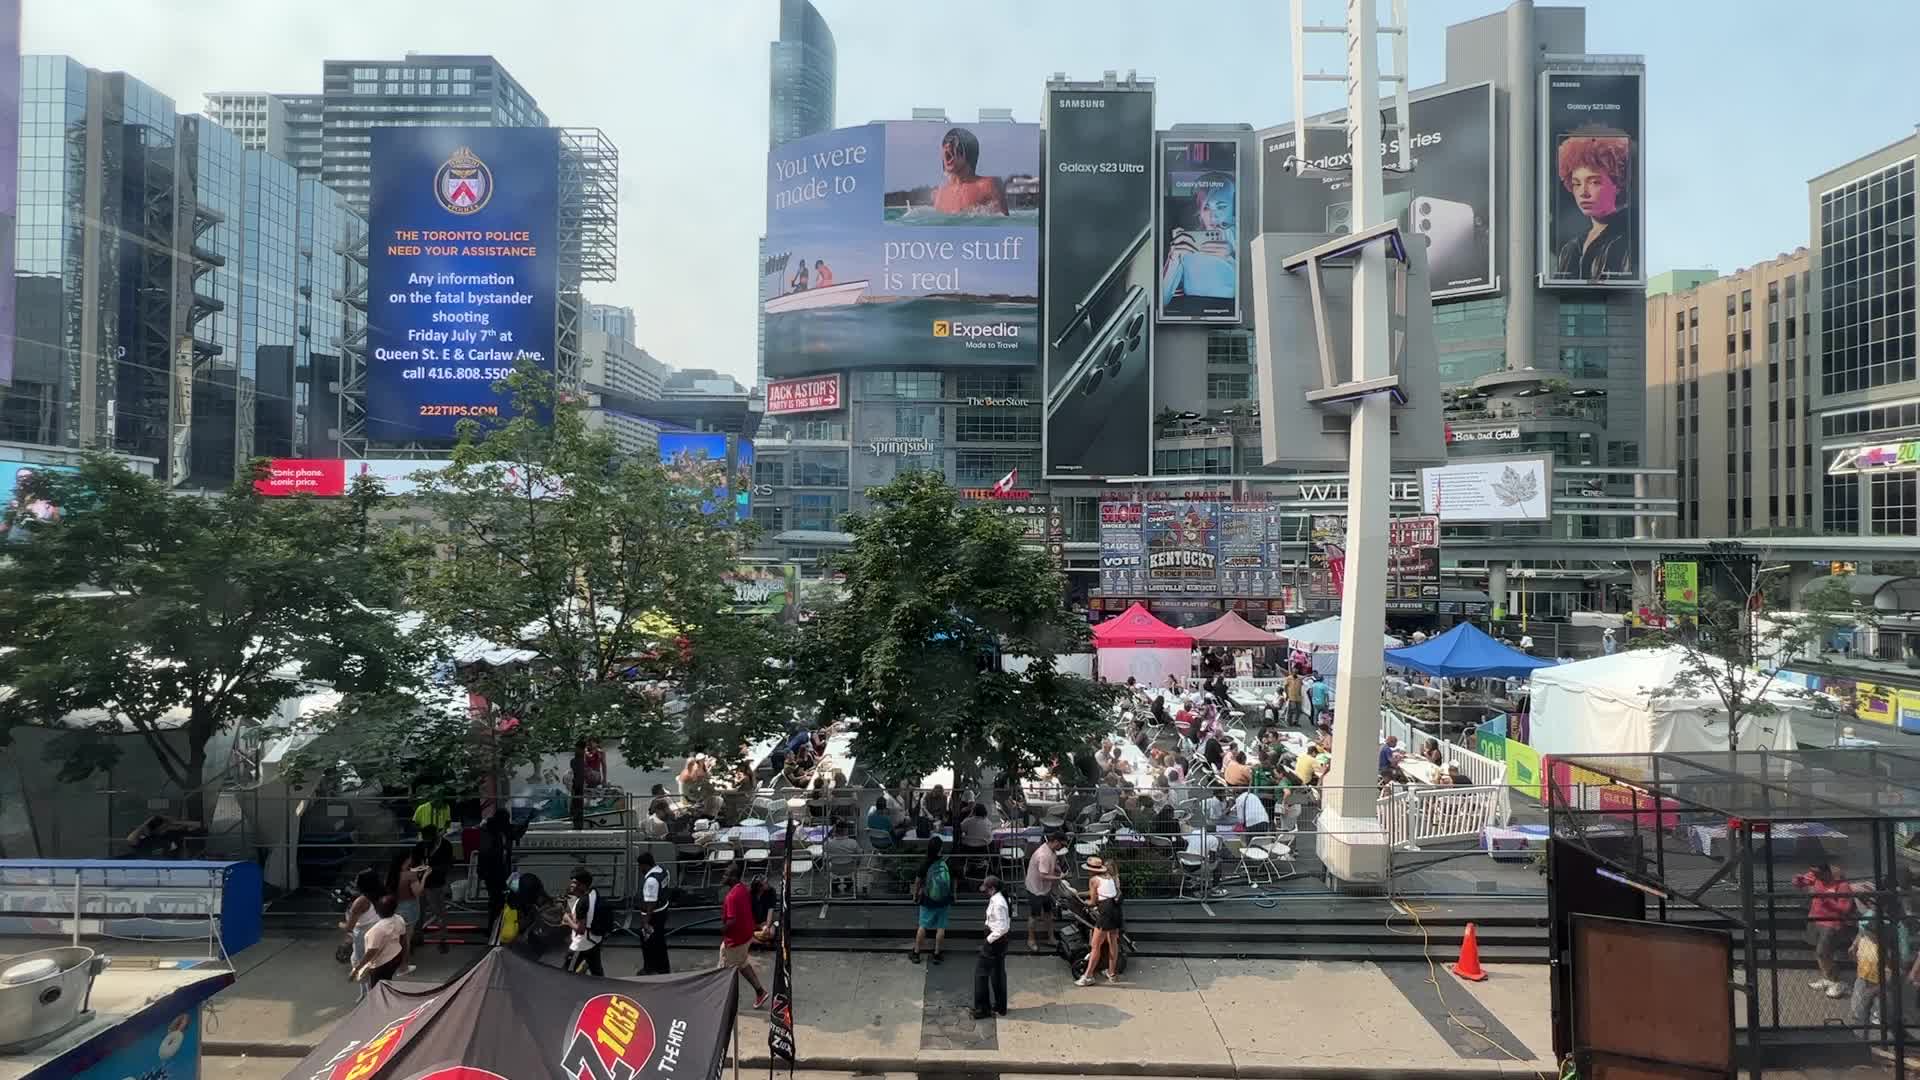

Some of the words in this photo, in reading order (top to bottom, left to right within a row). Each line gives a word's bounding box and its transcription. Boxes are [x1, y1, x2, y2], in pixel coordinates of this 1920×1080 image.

[1059, 100, 1105, 108] SAMSUNG
[1269, 140, 1296, 152] SAMSU
[1389, 132, 1442, 153] Sries
[775, 156, 808, 182] You
[812, 145, 867, 168] were
[1059, 163, 1098, 175] Galaxy
[1099, 163, 1118, 173] S23
[1118, 163, 1145, 173] Ultra
[775, 178, 828, 209] made
[834, 175, 857, 194] to
[394, 231, 419, 241] THE
[421, 231, 482, 241] TORONTO
[485, 231, 530, 241] POLICE
[388, 246, 421, 256] NEED
[424, 246, 459, 256] YOUR
[461, 246, 537, 257] ASSISTANCE
[883, 240, 955, 266] prove
[961, 236, 1024, 260] stuff
[408, 273, 434, 287] Any
[437, 272, 515, 286] information
[884, 268, 903, 290] is
[911, 267, 960, 291] real
[389, 293, 407, 304] on
[409, 291, 432, 304] the
[434, 291, 464, 304] fatal
[468, 291, 533, 306] bystander
[432, 310, 490, 326] shooting
[408, 329, 449, 344] Friday
[451, 329, 477, 344] July
[480, 329, 497, 341] 7th
[499, 331, 513, 342] at
[953, 322, 1018, 339] Expedia
[965, 341, 987, 349] Made
[987, 341, 996, 349] to
[997, 341, 1019, 349] Travel
[375, 348, 418, 361] Queen
[421, 348, 439, 361] St.
[442, 349, 451, 360] E
[454, 349, 465, 361] &
[468, 348, 513, 361] Carlaw
[515, 349, 545, 361] Ave.
[402, 366, 425, 379] call
[769, 385, 793, 401] JACK
[794, 380, 836, 399] ASTOR'S
[795, 398, 808, 408] THIS
[420, 406, 498, 416] 222TIPS.COM
[295, 468, 325, 479] phone.
[295, 478, 319, 488] price.
[1103, 556, 1141, 567] VOTE
[1149, 550, 1216, 570] KENTUCKY
[665, 1018, 688, 1047] HITS
[657, 1045, 681, 1072] THE
